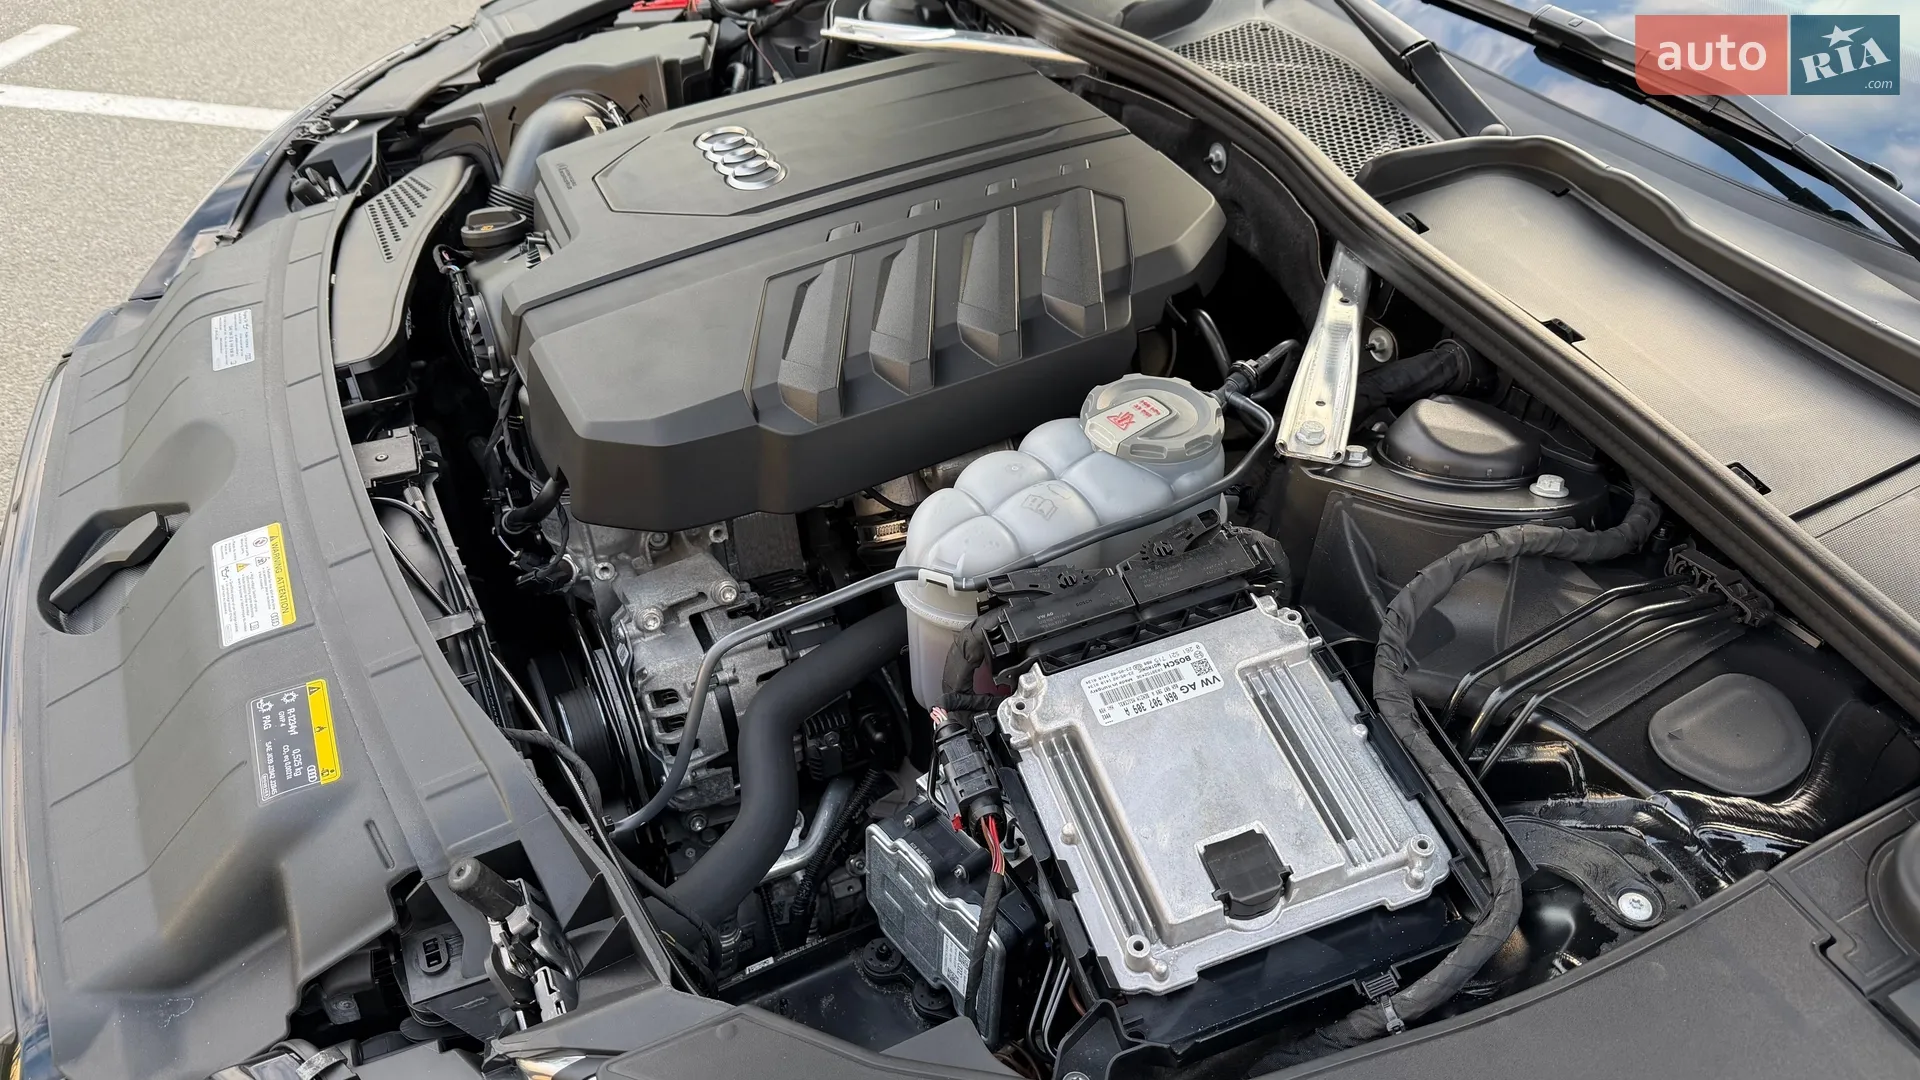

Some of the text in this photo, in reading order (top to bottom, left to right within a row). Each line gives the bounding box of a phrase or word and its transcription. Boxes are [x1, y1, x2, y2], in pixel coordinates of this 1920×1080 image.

[271, 541, 289, 614] WARNING ATTENTION
[1162, 654, 1191, 668] BOSCH
[1178, 674, 1221, 694] VW AG
[1131, 701, 1146, 713] 309
[1147, 696, 1163, 708] 907
[277, 710, 285, 723] GWP
[1123, 706, 1130, 716] A
[261, 714, 272, 730] PAG
[285, 707, 303, 777] R-1234yf 0,525 kg
